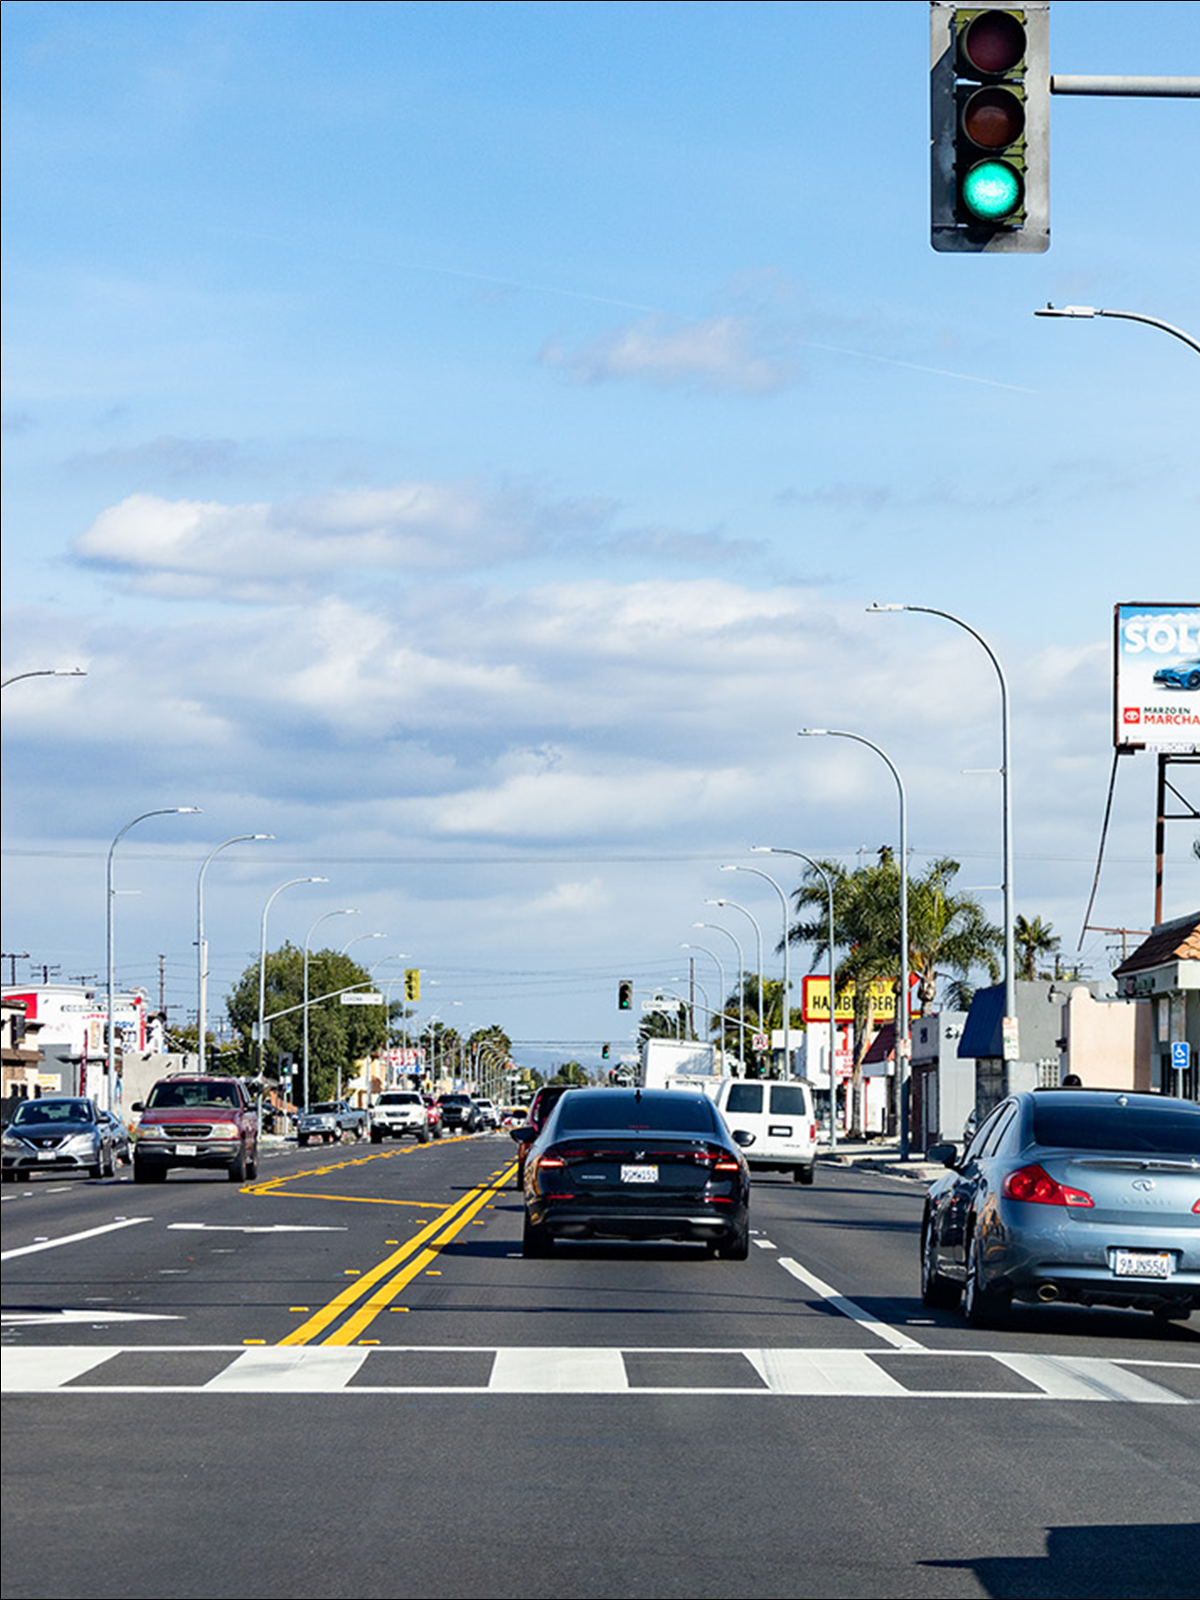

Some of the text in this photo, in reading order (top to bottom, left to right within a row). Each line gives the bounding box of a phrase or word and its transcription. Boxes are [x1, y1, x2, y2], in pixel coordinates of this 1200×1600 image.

[1143, 706, 1191, 715] MARZO EN
[1143, 714, 1200, 726] MARCHA
